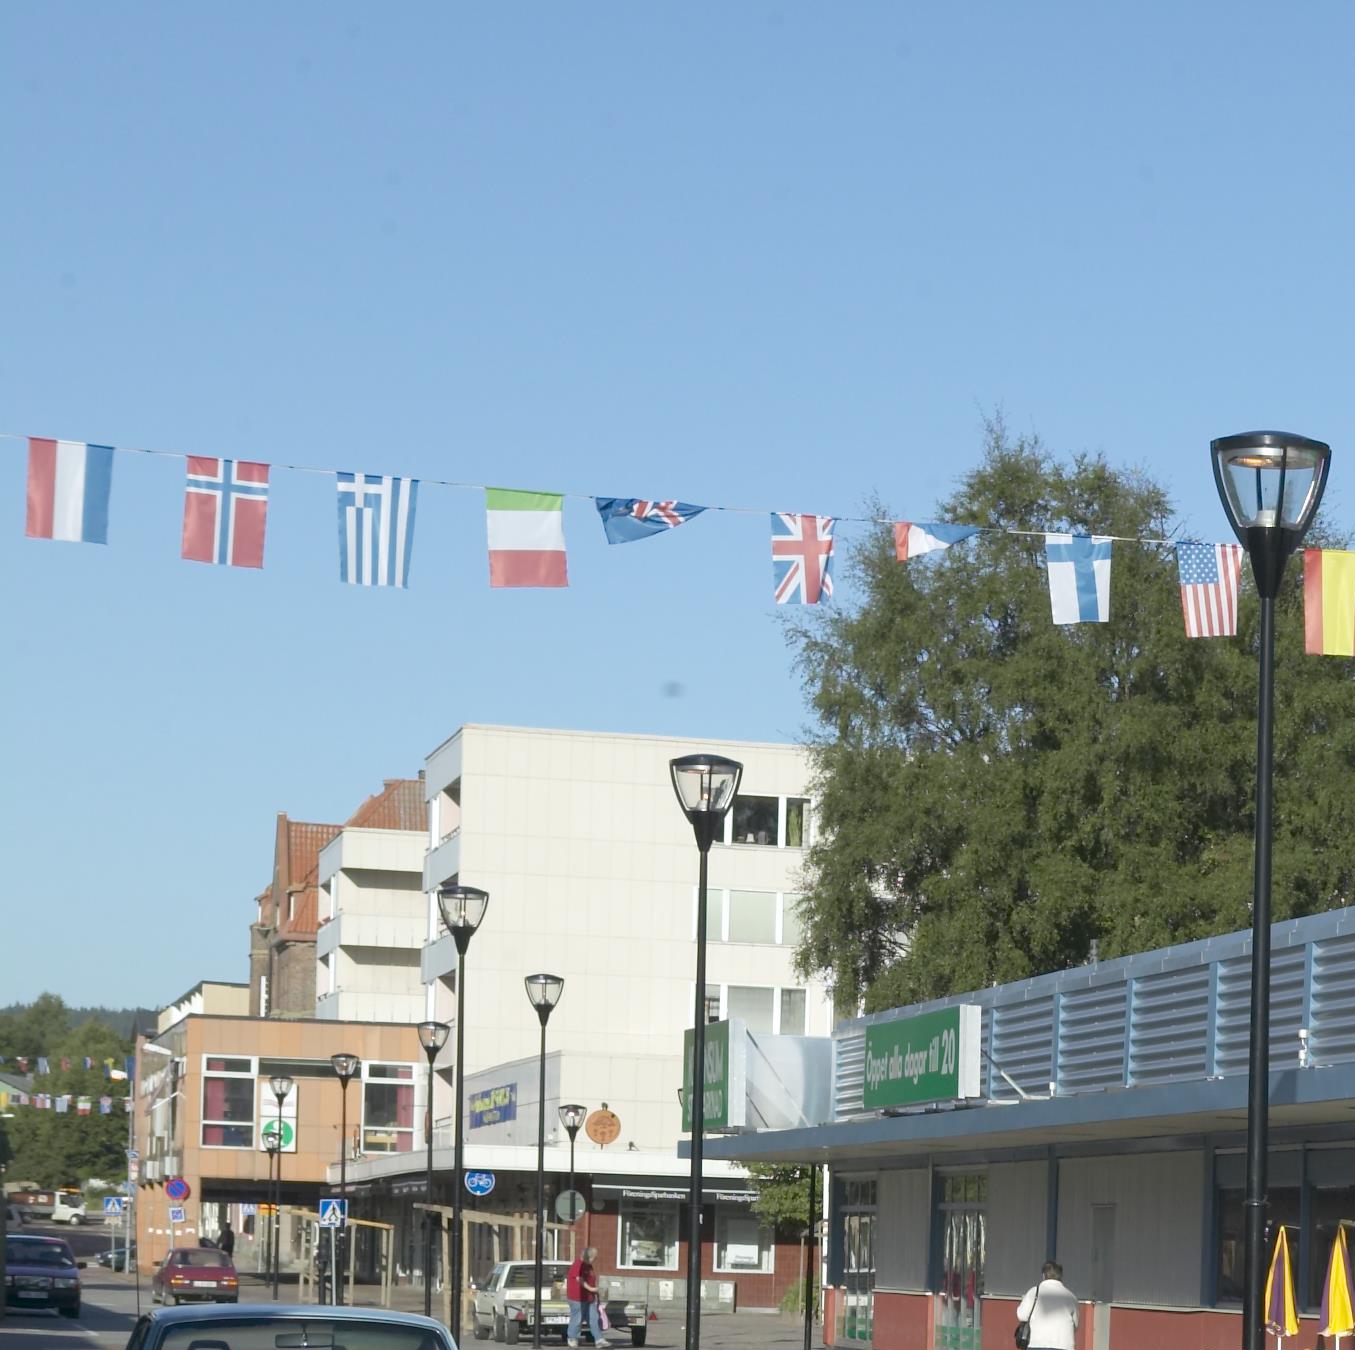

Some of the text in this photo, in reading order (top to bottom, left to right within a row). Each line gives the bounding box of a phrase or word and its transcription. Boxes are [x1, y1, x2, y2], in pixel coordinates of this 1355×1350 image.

[867, 1028, 956, 1090] Öppet alla dagar till 20
